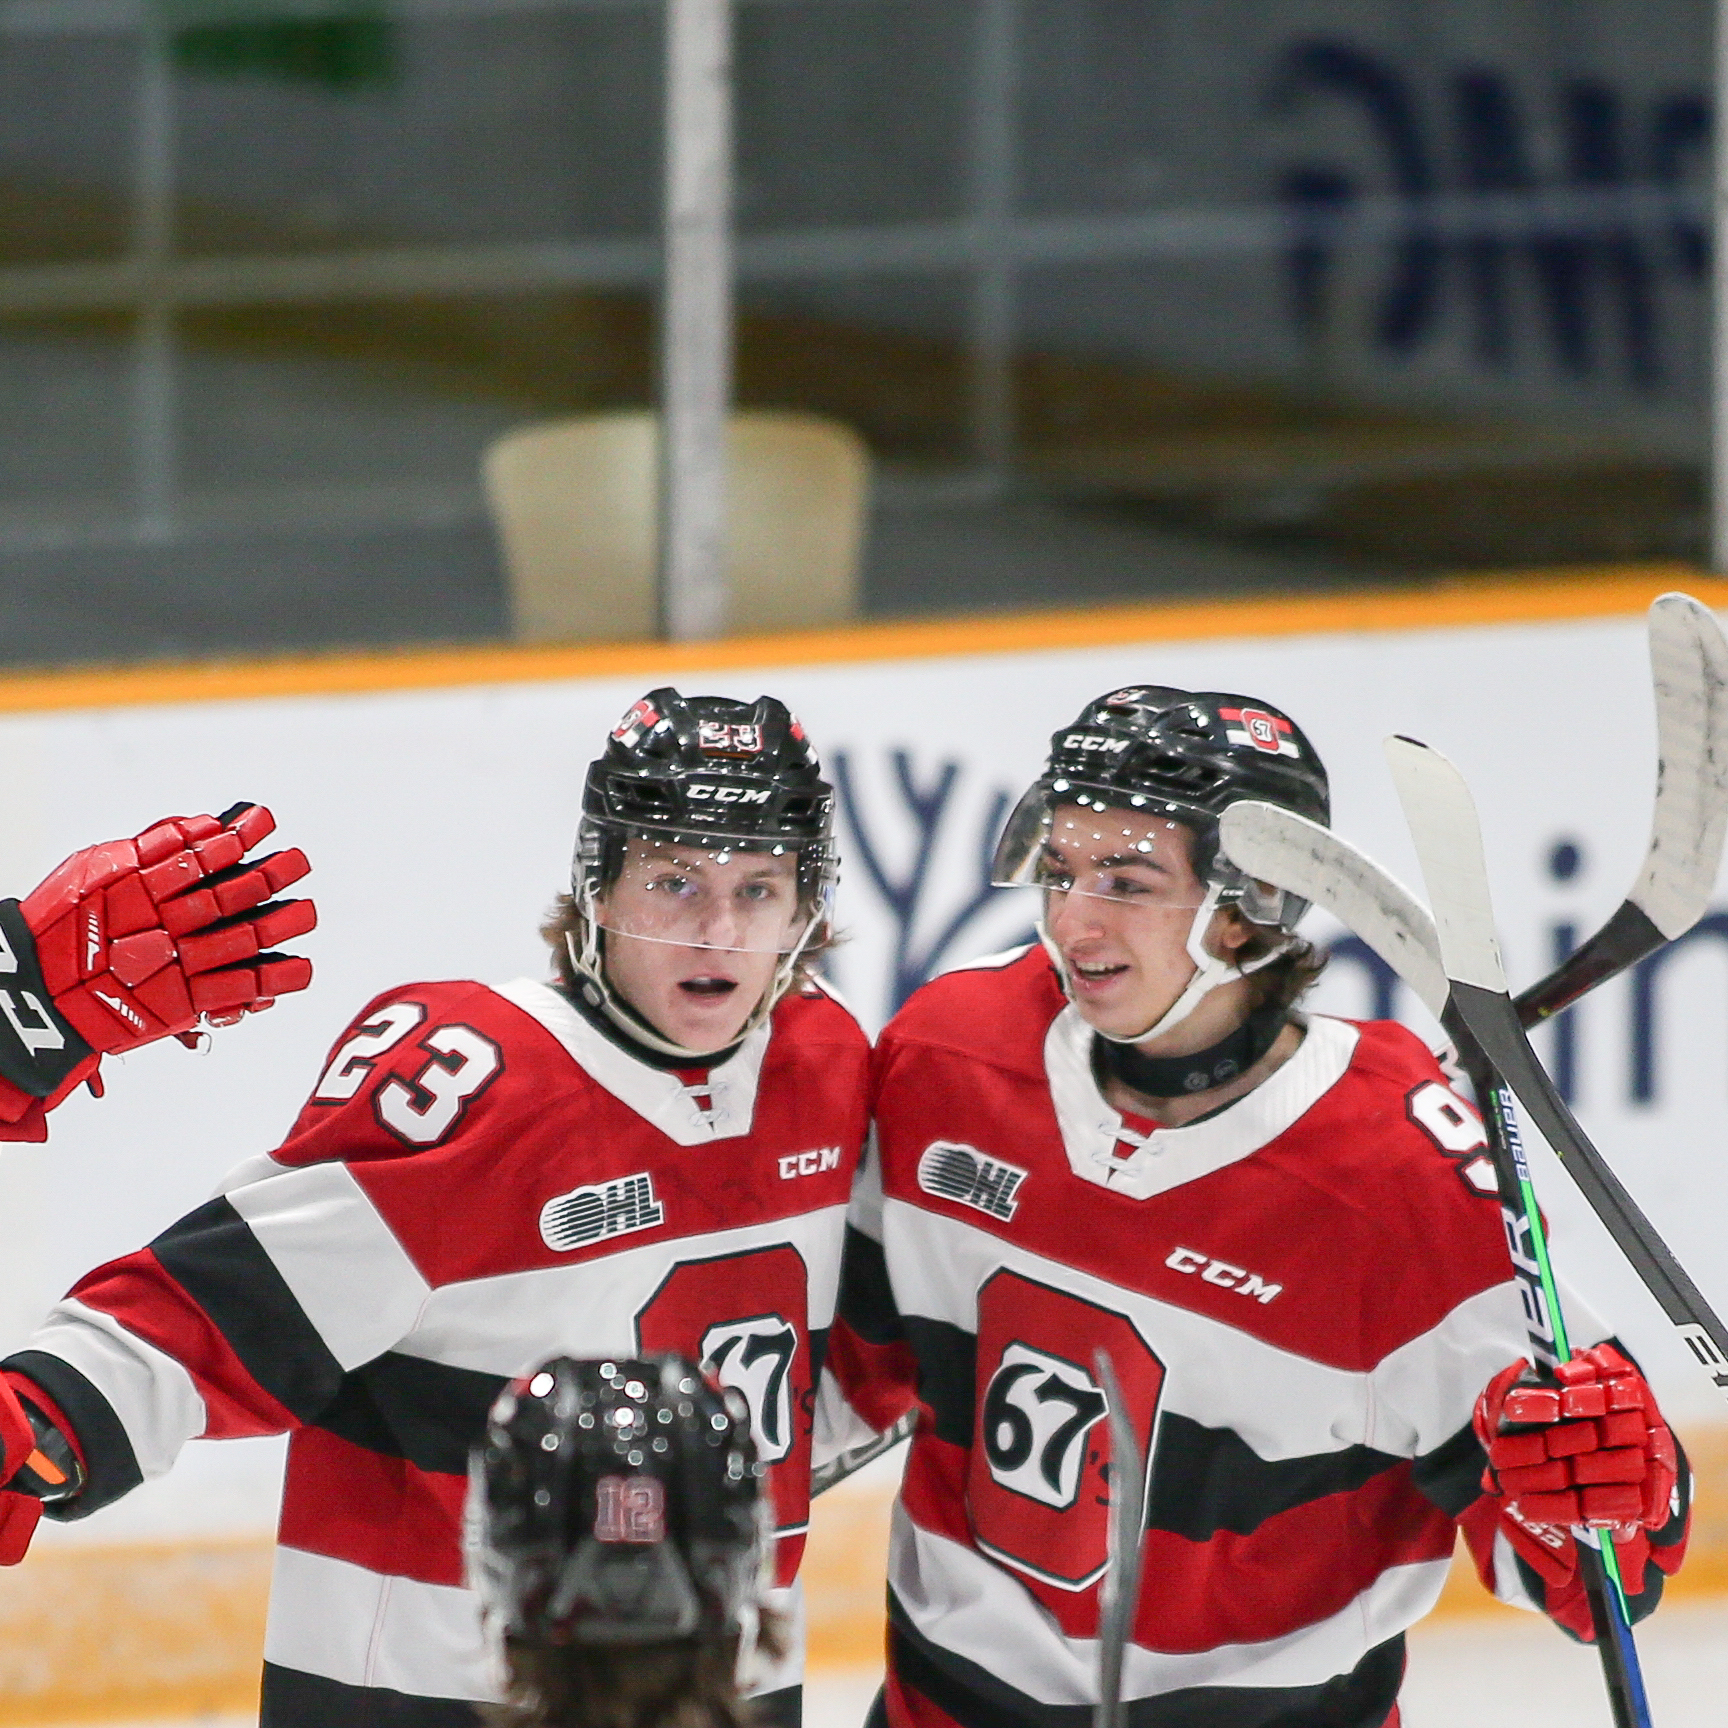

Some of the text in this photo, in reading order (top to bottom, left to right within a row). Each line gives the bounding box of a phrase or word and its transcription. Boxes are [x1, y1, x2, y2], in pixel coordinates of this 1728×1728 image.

[1063, 734, 1130, 753] CCM
[686, 784, 771, 804] CCM
[311, 1003, 505, 1147] 23
[778, 1146, 841, 1180] CCM
[1165, 1246, 1283, 1304] CCM
